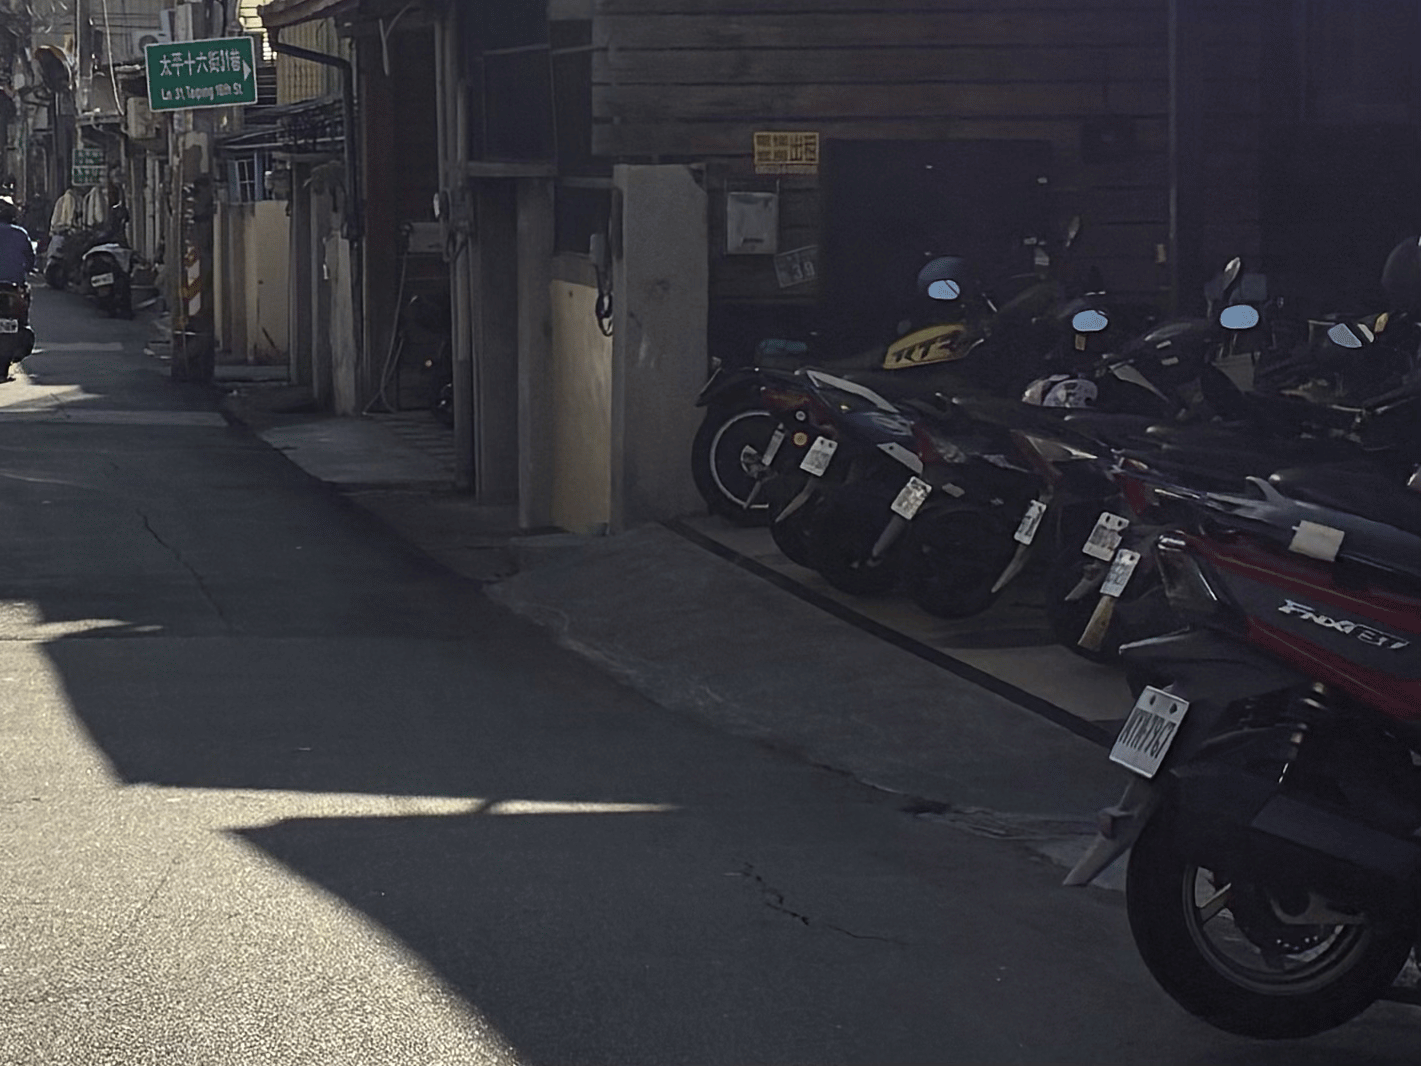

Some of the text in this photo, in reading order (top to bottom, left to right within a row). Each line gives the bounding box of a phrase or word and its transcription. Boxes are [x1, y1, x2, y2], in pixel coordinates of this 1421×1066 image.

[159, 48, 241, 77] 太平十六街31巷
